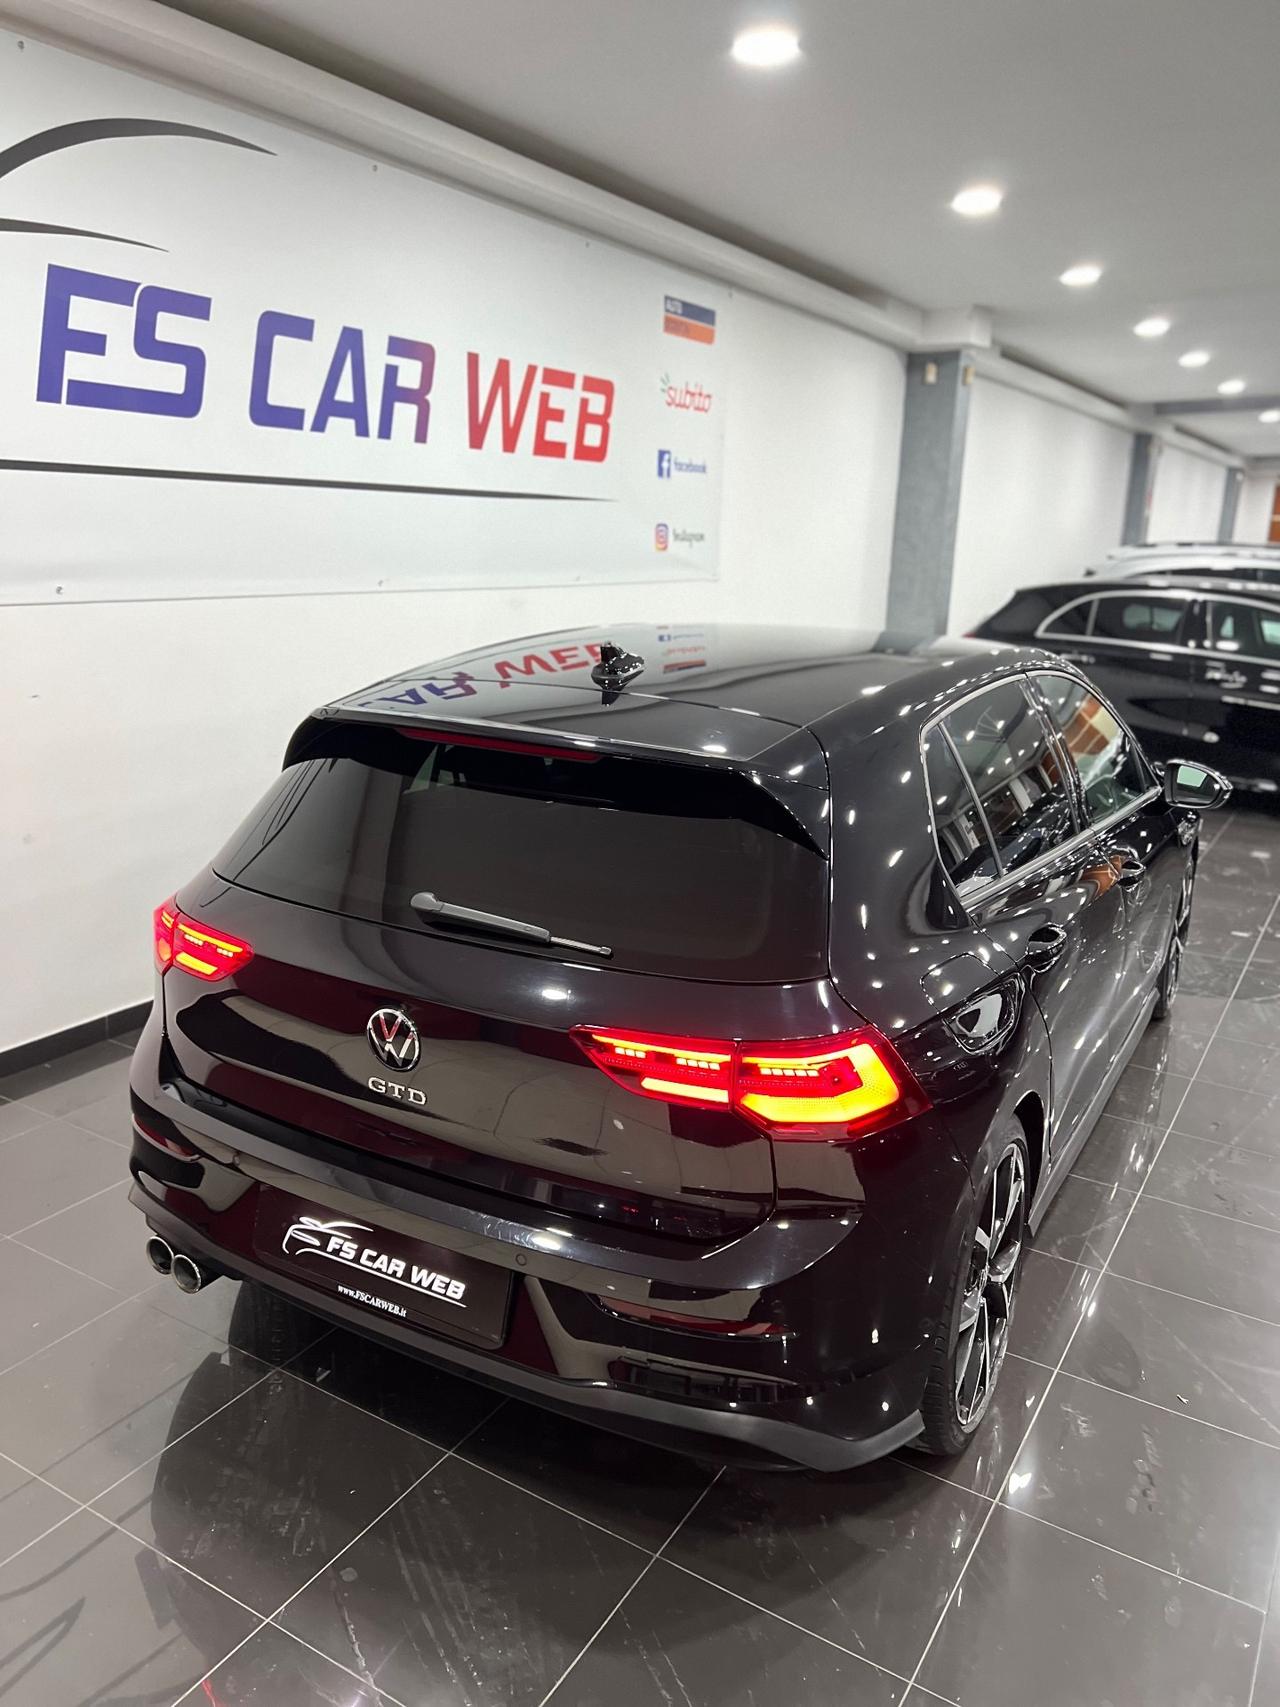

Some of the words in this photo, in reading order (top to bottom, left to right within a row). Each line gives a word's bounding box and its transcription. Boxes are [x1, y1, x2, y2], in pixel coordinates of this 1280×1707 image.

[36, 263, 212, 419] FS
[249, 309, 436, 445] CAR
[466, 351, 616, 464] WEB
[665, 382, 713, 413] subito
[368, 1077, 428, 1105] GTD
[326, 1236, 359, 1260] FS
[359, 1248, 407, 1278] CAR
[410, 1264, 467, 1301] WEB
[337, 1284, 407, 1318] www.FSCARWEB.it
